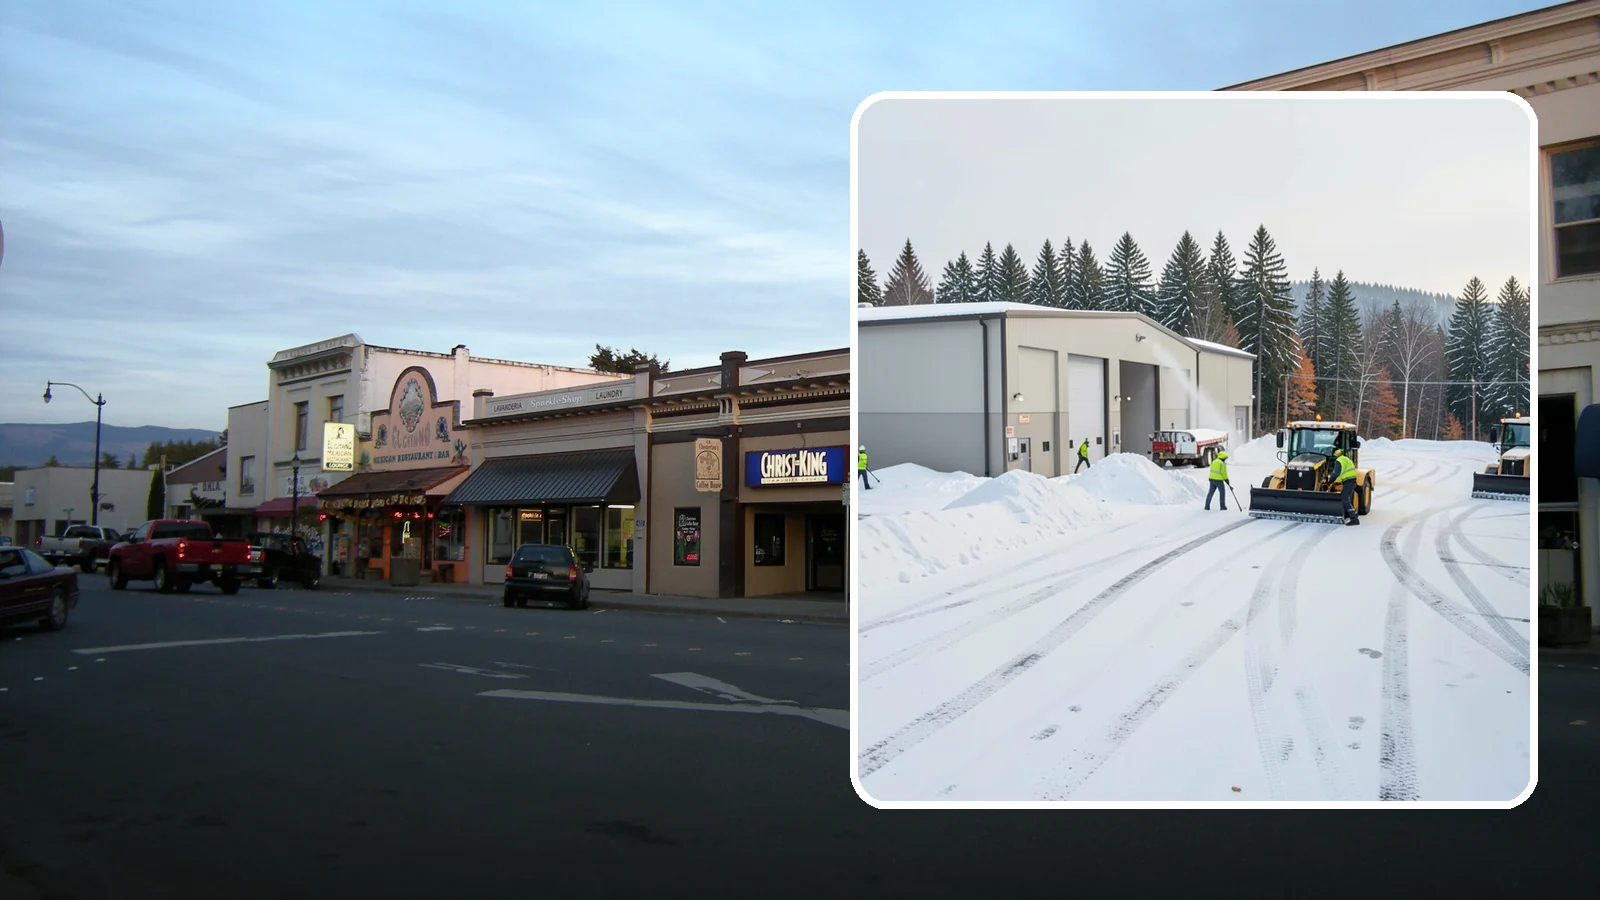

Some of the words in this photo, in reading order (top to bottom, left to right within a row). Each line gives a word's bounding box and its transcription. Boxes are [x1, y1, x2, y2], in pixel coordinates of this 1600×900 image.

[596, 389, 623, 400] LAUNDRY
[493, 402, 522, 412] LAVANDERIA
[373, 454, 396, 464] MEXICAN
[397, 452, 433, 462] RESTAURANT
[438, 450, 450, 458] BAR
[760, 452, 798, 478] CHRIST
[799, 450, 828, 476] KING
